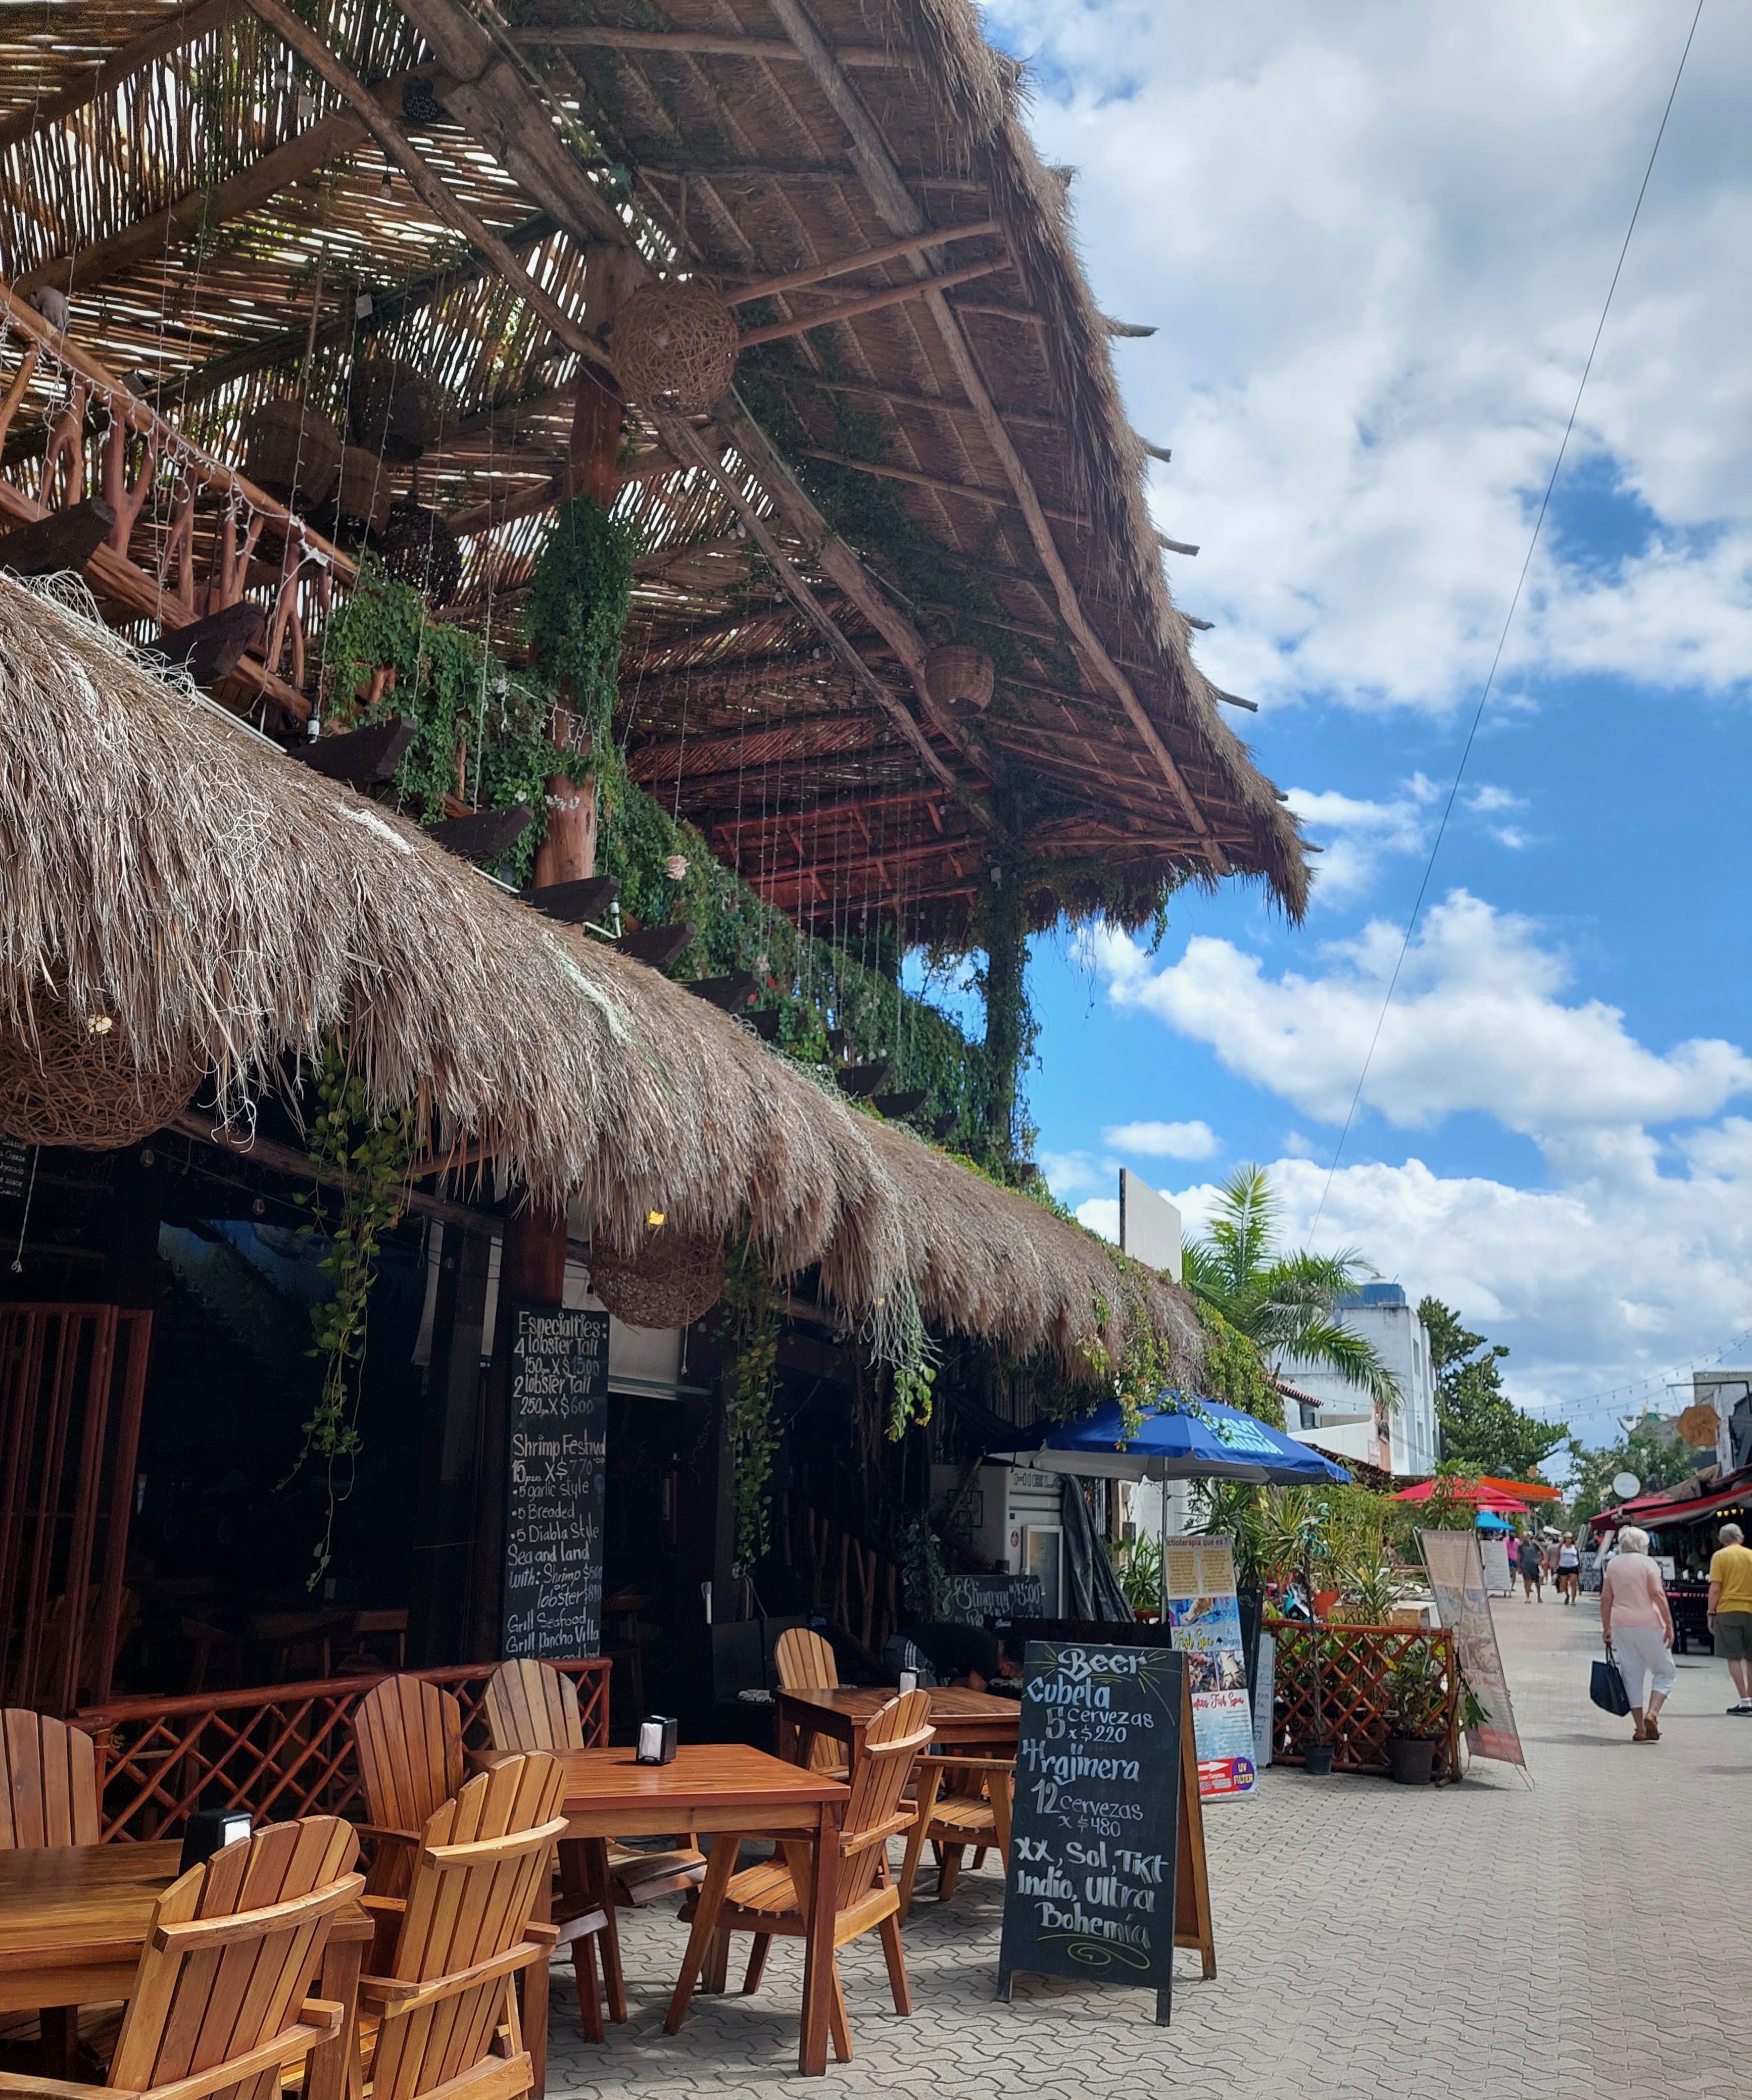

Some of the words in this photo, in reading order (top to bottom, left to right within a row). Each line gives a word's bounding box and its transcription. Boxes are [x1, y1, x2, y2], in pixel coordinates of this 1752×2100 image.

[513, 1337, 524, 1358] 4
[528, 1334, 573, 1355] lobster
[575, 1337, 598, 1356] Tail
[513, 1375, 523, 1397] 2
[525, 1373, 565, 1394] lobster
[512, 1433, 560, 1462] Shrimp
[527, 1481, 555, 1502] garlic
[560, 1476, 590, 1500] style
[528, 1520, 568, 1544] Diabla
[570, 1511, 599, 1543] Style
[508, 1543, 532, 1566] Sea
[534, 1544, 557, 1563] and
[561, 1540, 590, 1562] land
[543, 1562, 580, 1587] Shrimp
[554, 1583, 567, 1591] or
[537, 1584, 586, 1609] lobster
[507, 1608, 533, 1633] Grill
[537, 1606, 587, 1629] Seafood
[506, 1631, 534, 1653] Grill
[574, 1618, 600, 1643] Villa
[1057, 1648, 1148, 1682] Beer
[1027, 1674, 1110, 1709] Cubeta
[1046, 1706, 1065, 1739] 5
[1080, 1724, 1127, 1742] $220
[1031, 1778, 1062, 1814] 12
[1077, 1815, 1121, 1837] $480
[1086, 1876, 1155, 1913] Ultra
